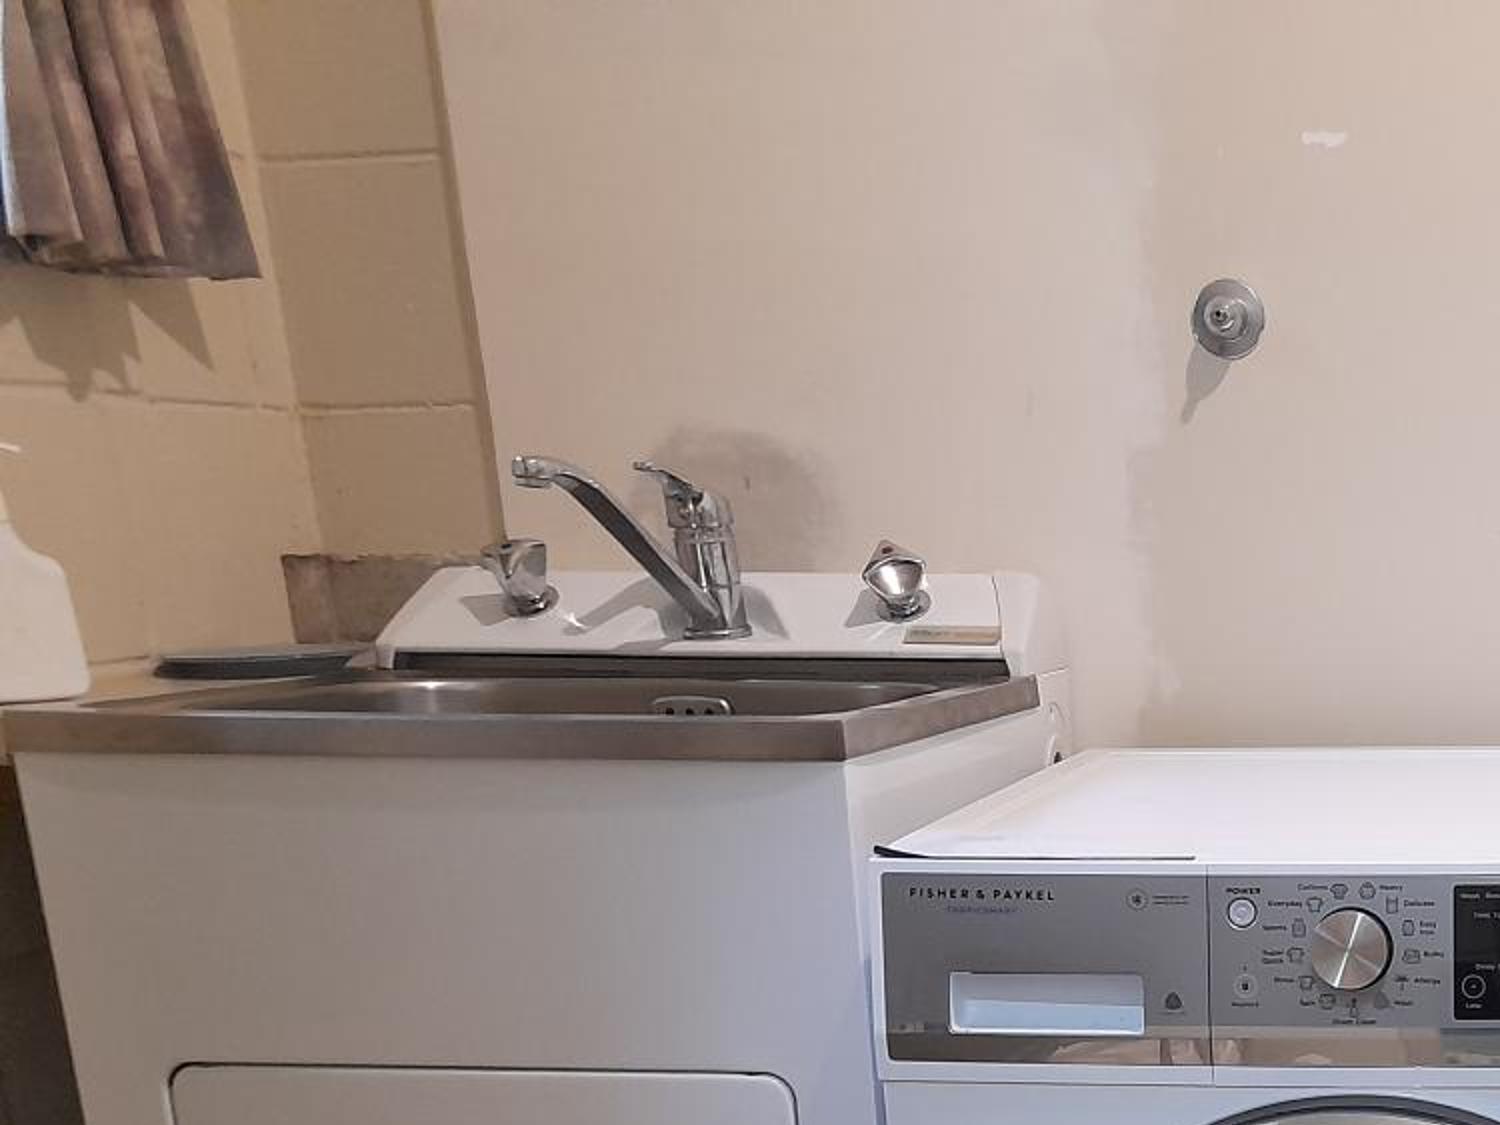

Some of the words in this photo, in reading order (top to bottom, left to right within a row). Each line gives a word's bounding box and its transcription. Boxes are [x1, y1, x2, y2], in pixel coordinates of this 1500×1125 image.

[909, 887, 970, 900] FISHER
[976, 888, 985, 900] &
[993, 888, 1055, 901] PAYKEL
